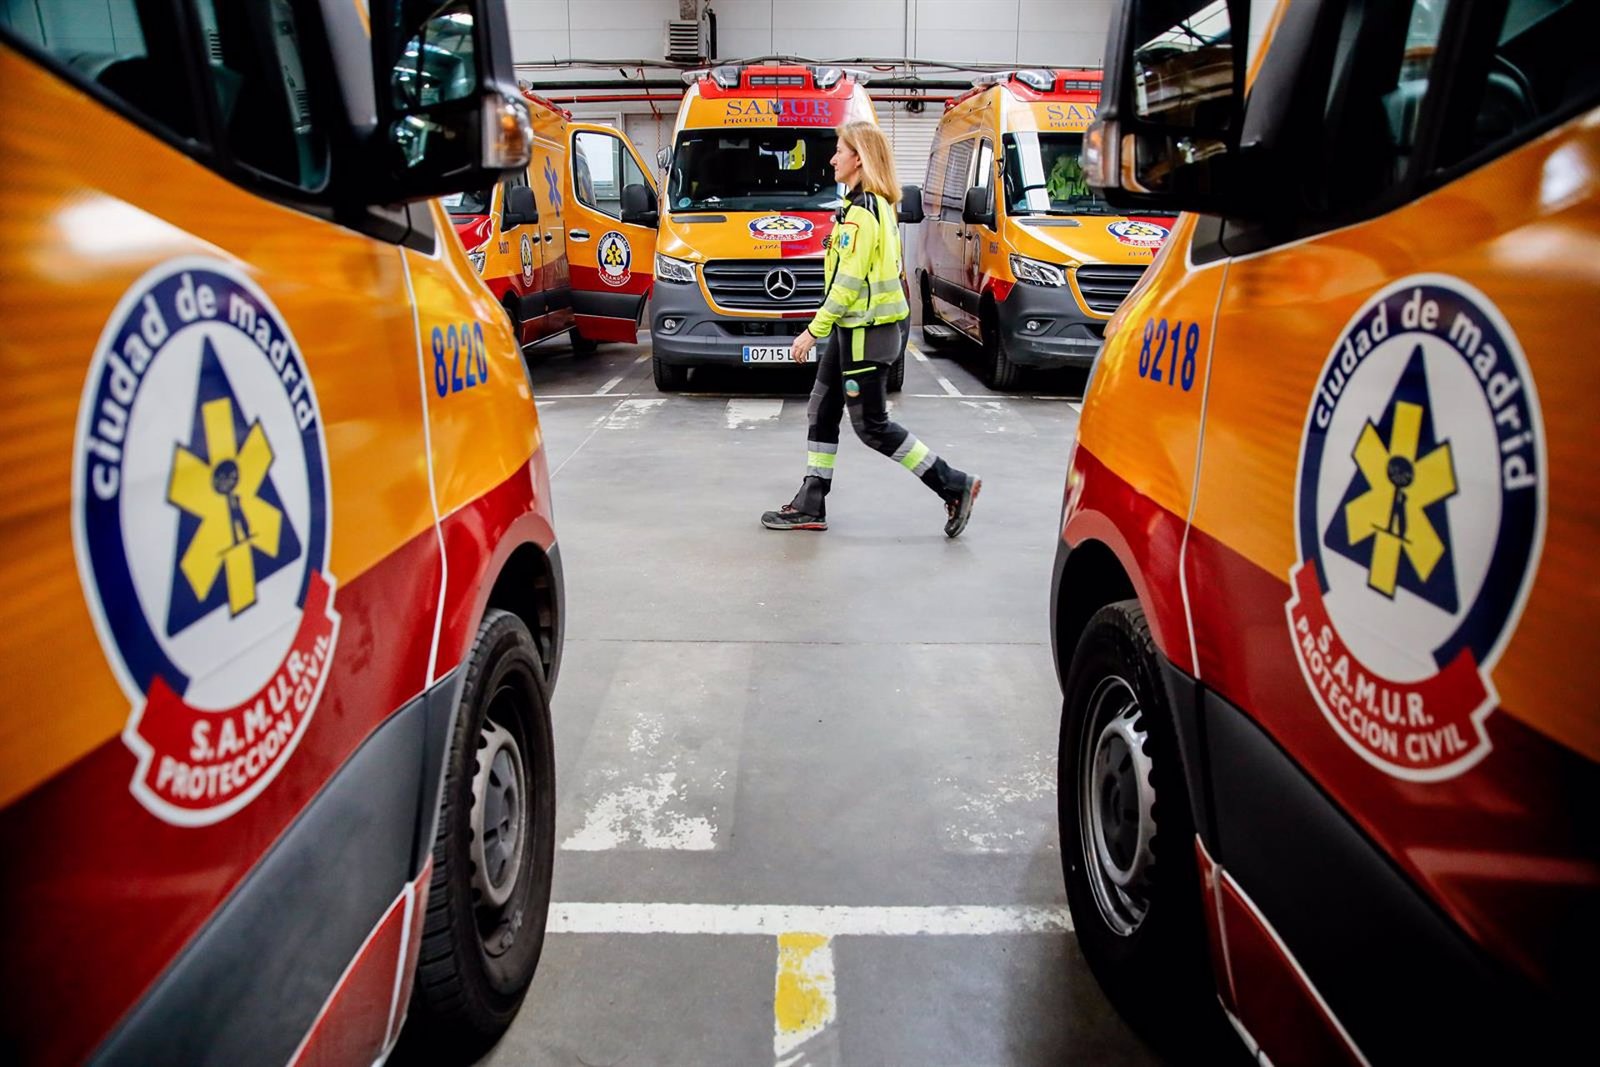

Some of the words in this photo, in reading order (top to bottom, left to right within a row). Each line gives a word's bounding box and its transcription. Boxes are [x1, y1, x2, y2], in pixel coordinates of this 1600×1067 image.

[726, 98, 832, 116] SAMUR
[84, 291, 169, 500] ciudad
[175, 271, 218, 323] de
[229, 292, 315, 431] madrid
[432, 321, 488, 398] 8220
[751, 348, 784, 361] 0715
[787, 348, 812, 361] LT
[1139, 317, 1199, 392] 8218
[1315, 302, 1389, 429] ciudad
[1401, 287, 1440, 329] de
[1449, 312, 1537, 491] madrid
[156, 711, 294, 799] PROTECCION
[293, 634, 331, 712] CIVIL
[190, 650, 310, 761] S.A.M.U.R.
[1296, 615, 1399, 757] PROTECCION
[1405, 723, 1467, 762] CIVIL
[1318, 624, 1433, 727] S.A.M.U.R.
